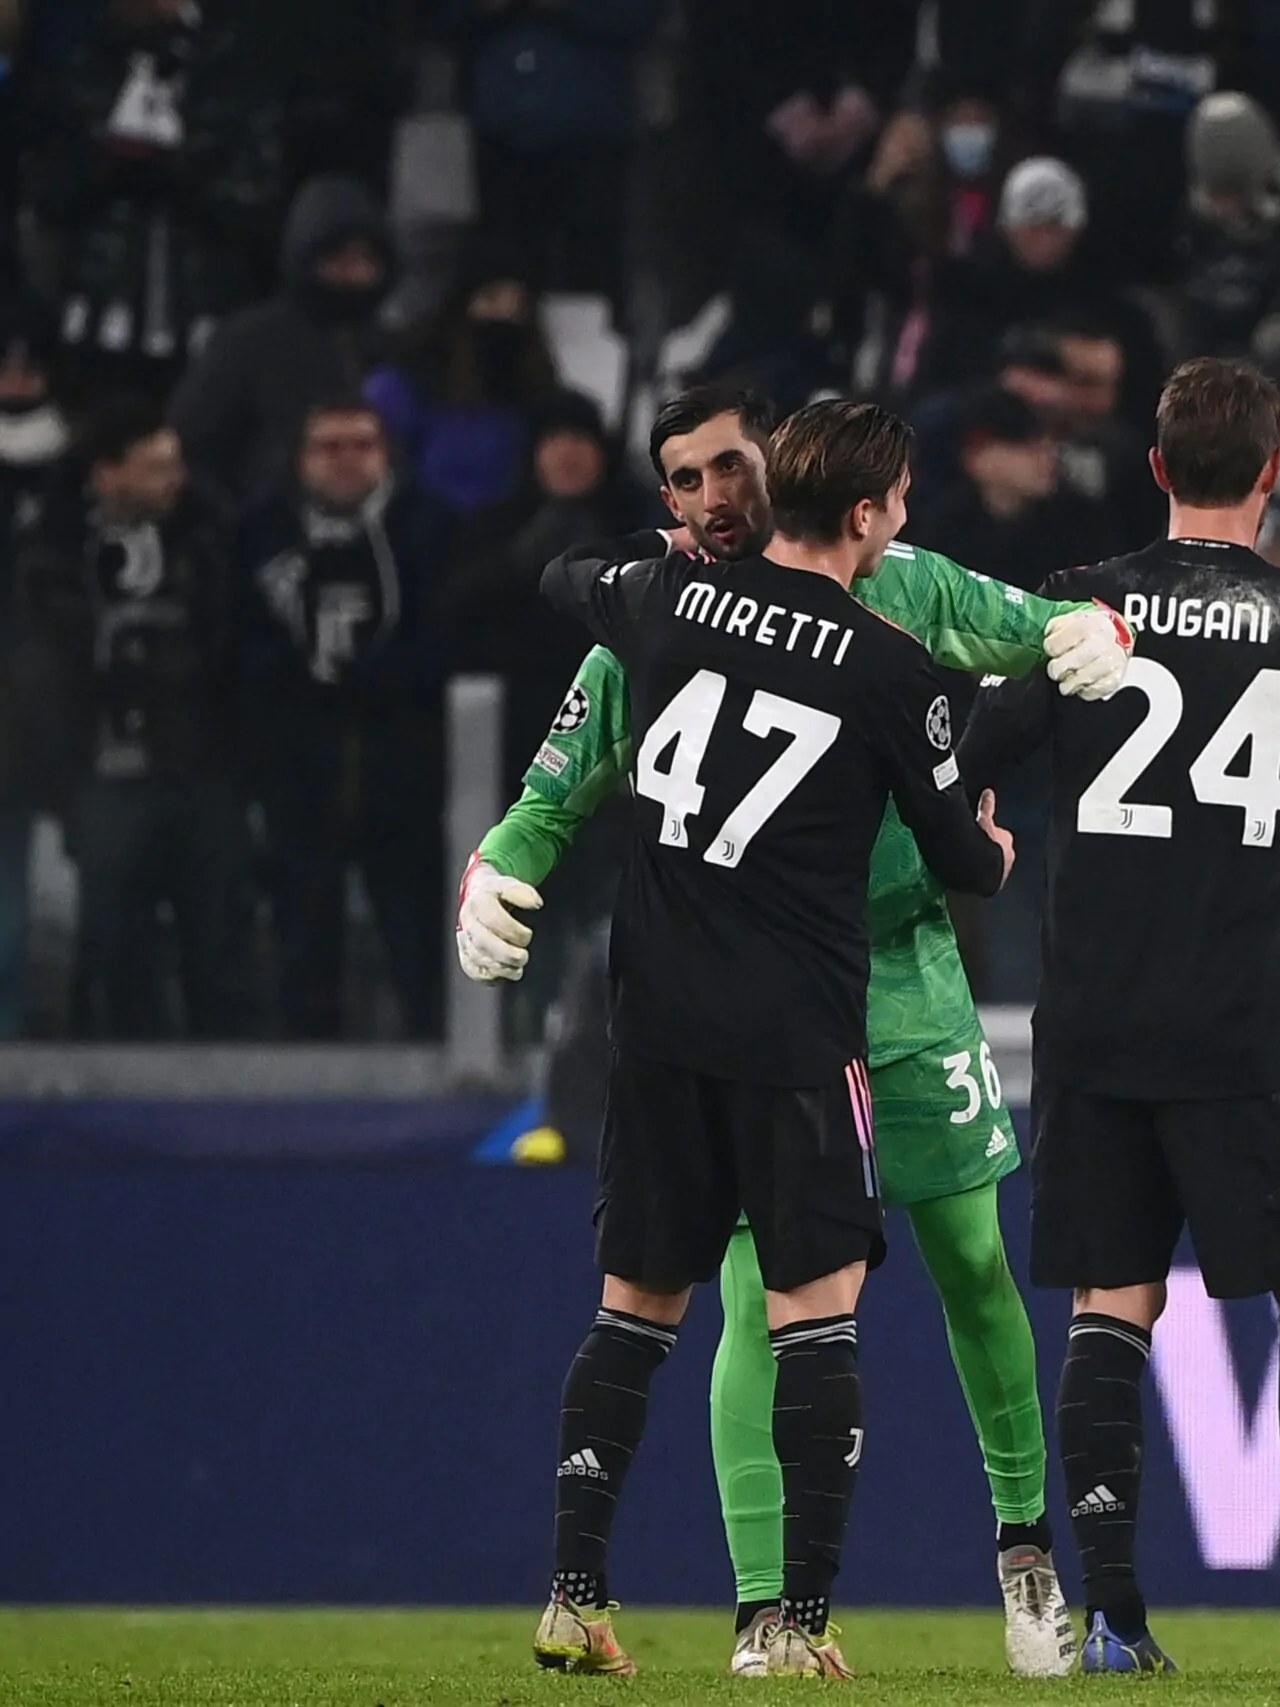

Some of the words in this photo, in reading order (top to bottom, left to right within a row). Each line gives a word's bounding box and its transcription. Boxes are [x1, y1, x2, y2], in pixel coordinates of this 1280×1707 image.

[674, 581, 854, 666] MIRETTI
[1124, 593, 1270, 644] RUGANI
[636, 668, 842, 869] 47
[942, 1040, 1002, 1124] 36
[556, 1465, 609, 1480] adidas
[1071, 1501, 1126, 1518] adidas
